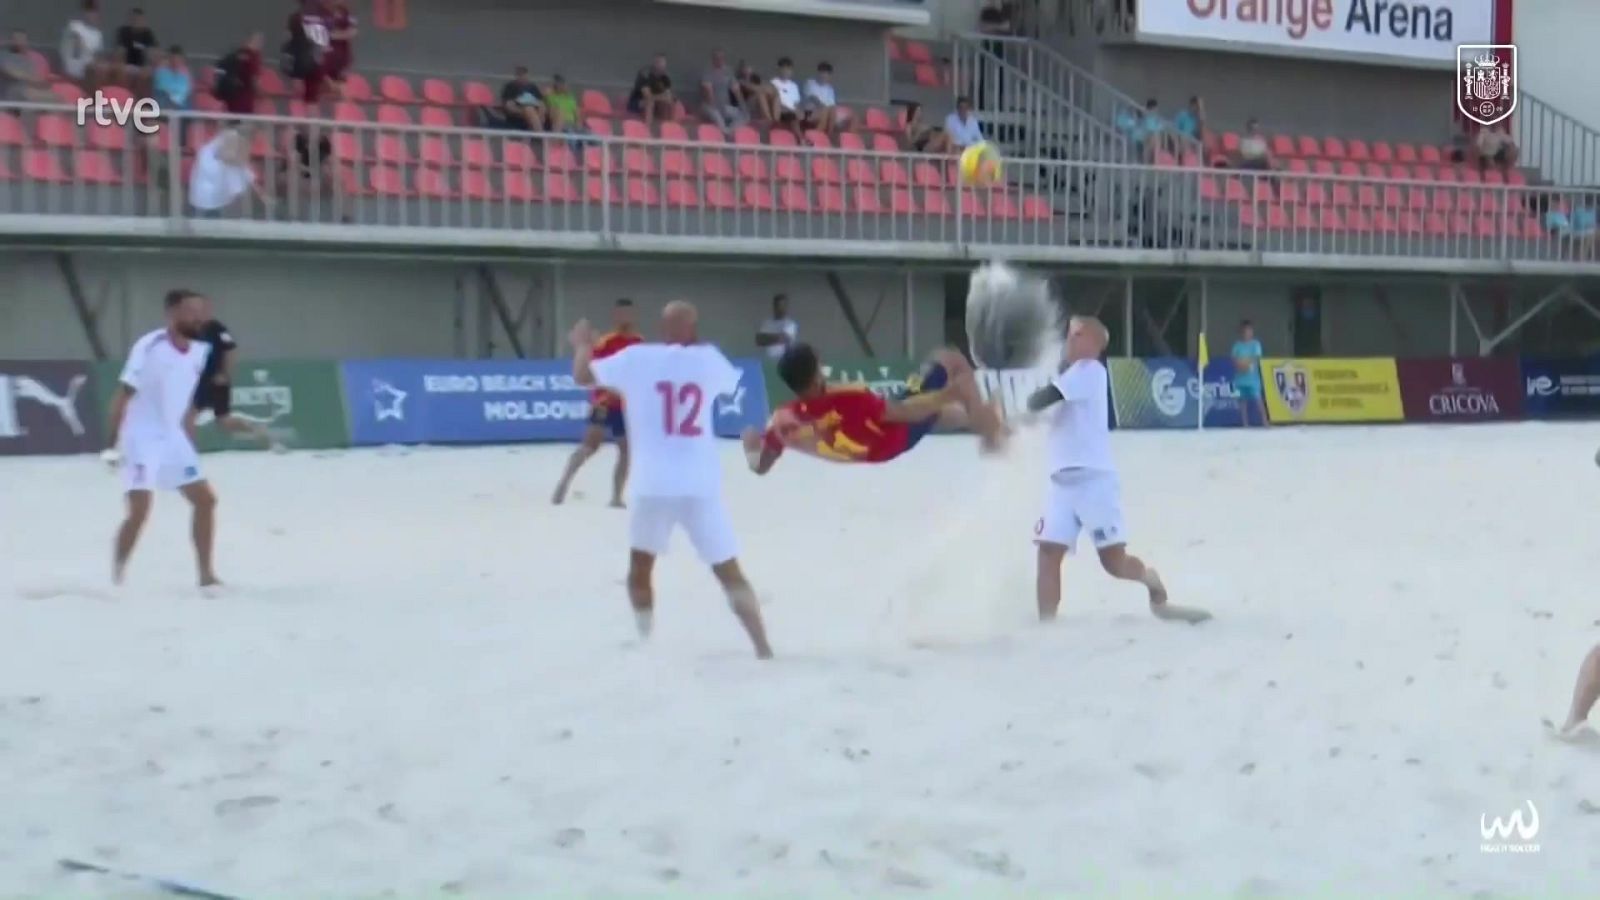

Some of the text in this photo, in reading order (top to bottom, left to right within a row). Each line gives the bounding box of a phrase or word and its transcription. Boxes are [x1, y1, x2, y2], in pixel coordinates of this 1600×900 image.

[1345, 0, 1453, 41] Arena
[481, 375, 545, 391] BEACH
[656, 381, 703, 436] 12
[1429, 393, 1499, 414] CRICOVA
